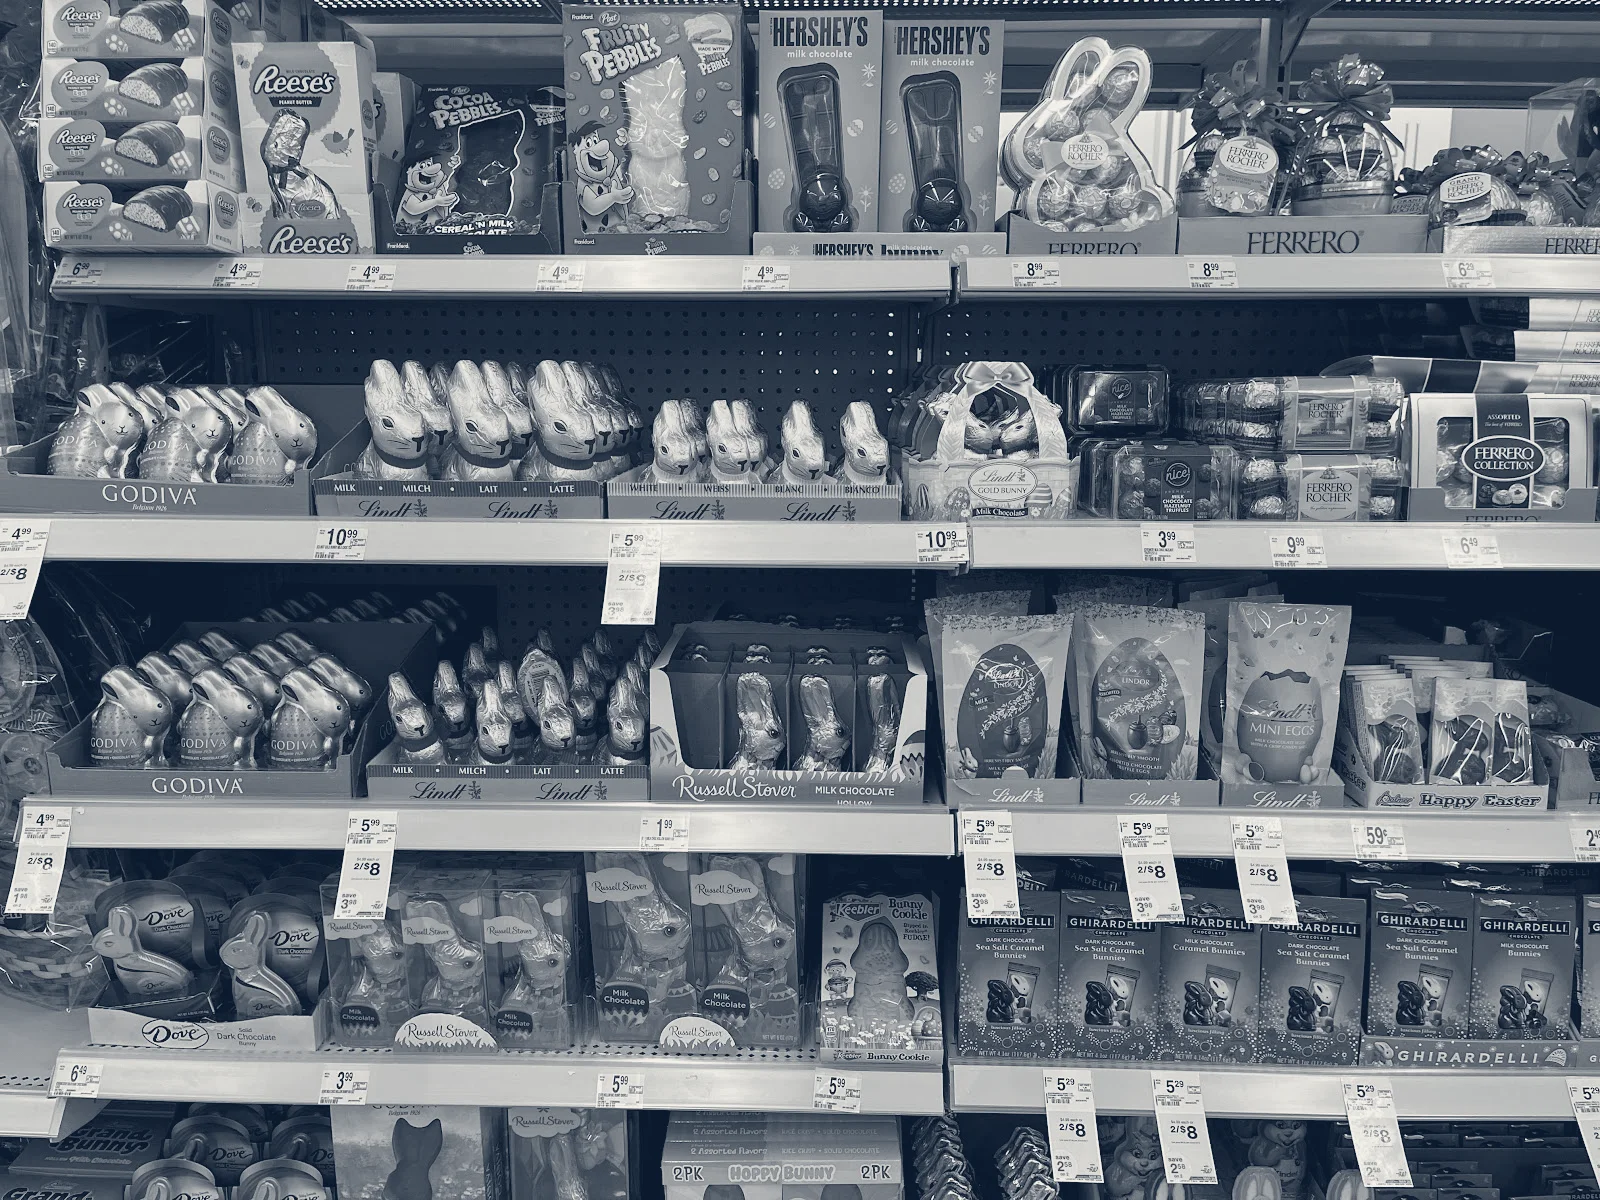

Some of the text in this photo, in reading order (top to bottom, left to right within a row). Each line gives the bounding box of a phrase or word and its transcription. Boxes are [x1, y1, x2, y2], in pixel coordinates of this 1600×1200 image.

[60, 7, 103, 21] Reese's
[601, 12, 618, 22] Post
[581, 22, 650, 52] FRUITY
[773, 17, 869, 47] HERSHEY'S
[896, 26, 991, 55] HERSHEY'S
[579, 36, 662, 84] PEBBLES
[787, 50, 852, 58] milk chocolate
[910, 58, 974, 67] milk chocolate
[58, 70, 101, 85] Reese's
[253, 64, 336, 95] Reese's
[434, 92, 494, 110] COCOA
[429, 100, 502, 129] PEBBLES
[56, 128, 97, 146] Reese's
[1068, 144, 1104, 154] FERRERO
[1228, 146, 1269, 162] FERRERO
[1067, 151, 1101, 162] ROCHER
[1226, 154, 1266, 170] ROCHER
[1451, 175, 1481, 183] GRAND
[1446, 179, 1485, 193] FERRERO
[1448, 185, 1482, 200] ROCHER
[62, 192, 104, 209] Reese's
[435, 225, 473, 234] CEREAL
[486, 219, 514, 229] MILK
[269, 226, 353, 254] Reese's
[1247, 230, 1359, 254] FERRERO
[1308, 403, 1344, 411] FERRERO
[1308, 410, 1342, 418] ROCHER
[1487, 413, 1521, 421] ASSORTED
[1474, 447, 1535, 460] FERRERO
[1473, 461, 1534, 471] COLLECTION
[984, 469, 1016, 484] Lindt
[1165, 468, 1191, 481] nice!
[334, 484, 356, 492] MILK
[402, 484, 431, 492] MILCH
[479, 485, 498, 493] LAIT
[629, 484, 804, 493] WHITE WEISS BLANC
[845, 486, 880, 494] BIANCO
[1000, 486, 1027, 494] BUNNY
[1306, 483, 1352, 494] FERRERO
[102, 484, 197, 506] GODIVA
[1306, 492, 1351, 503] ROCHER
[488, 501, 544, 519] Lindt
[651, 501, 711, 520] Lindt
[994, 508, 1026, 517] Chocolate
[1250, 723, 1314, 736] MINI EGGS
[90, 737, 138, 749] GODIVA
[181, 737, 227, 749] GODIVA
[271, 739, 318, 751] GODIVA
[458, 767, 624, 775] MILCH LAIT LATTE
[152, 778, 243, 794] GODIVA
[410, 781, 468, 800] Lindt
[535, 781, 593, 801] Lindt
[672, 776, 796, 801] Russell Stover
[815, 787, 895, 796] MILK CHOCOLATE
[988, 788, 1033, 803] Lindt
[1129, 792, 1170, 807] Lindt
[1246, 790, 1307, 808] Lindt
[1418, 793, 1541, 808] Happy Easter
[353, 862, 380, 876] 2/$8
[976, 863, 1005, 876] 2/$8
[1137, 864, 1165, 878] 2/$8
[1249, 869, 1278, 882] 2/$8
[591, 881, 648, 893] Russell Stover
[695, 882, 753, 896] Russell Stover
[888, 898, 923, 910] Bunny
[837, 905, 880, 917] Keebler
[892, 910, 928, 920] Cookie
[971, 917, 1051, 926] GHIRARDELLI
[1070, 918, 1152, 929] GHIRARDELLI
[1381, 915, 1464, 929] GHIRARDELLI
[1483, 921, 1567, 934] GHIRARDELLI
[404, 926, 450, 935] Russell Stover
[487, 925, 533, 935] Russell Stover
[1010, 944, 1045, 952] Caramel
[1173, 944, 1245, 956] Caramel Bunnies
[1403, 944, 1419, 952] Salt
[1421, 946, 1458, 954] Caramel
[1508, 950, 1541, 958] Bunnies
[1405, 952, 1439, 961] Bunnies
[612, 989, 629, 997] Milk
[713, 992, 730, 1001] Milk
[603, 996, 646, 1006] Chocolate
[704, 999, 746, 1010] Chocolate
[342, 1014, 375, 1022] Chocolate
[238, 1033, 277, 1041] Chocolate
[404, 1023, 479, 1040] Russell Stover
[669, 1026, 723, 1038] Russell Stover
[1398, 1050, 1538, 1068] GHIRARDELLI
[511, 1115, 574, 1128] Russell Stover
[1059, 1123, 1086, 1137] 2/$8
[1170, 1126, 1198, 1139] 2/$8
[49, 1139, 150, 1155] Bunny
[673, 1164, 892, 1182] 2PK HOPPY BUNNY 2PK
